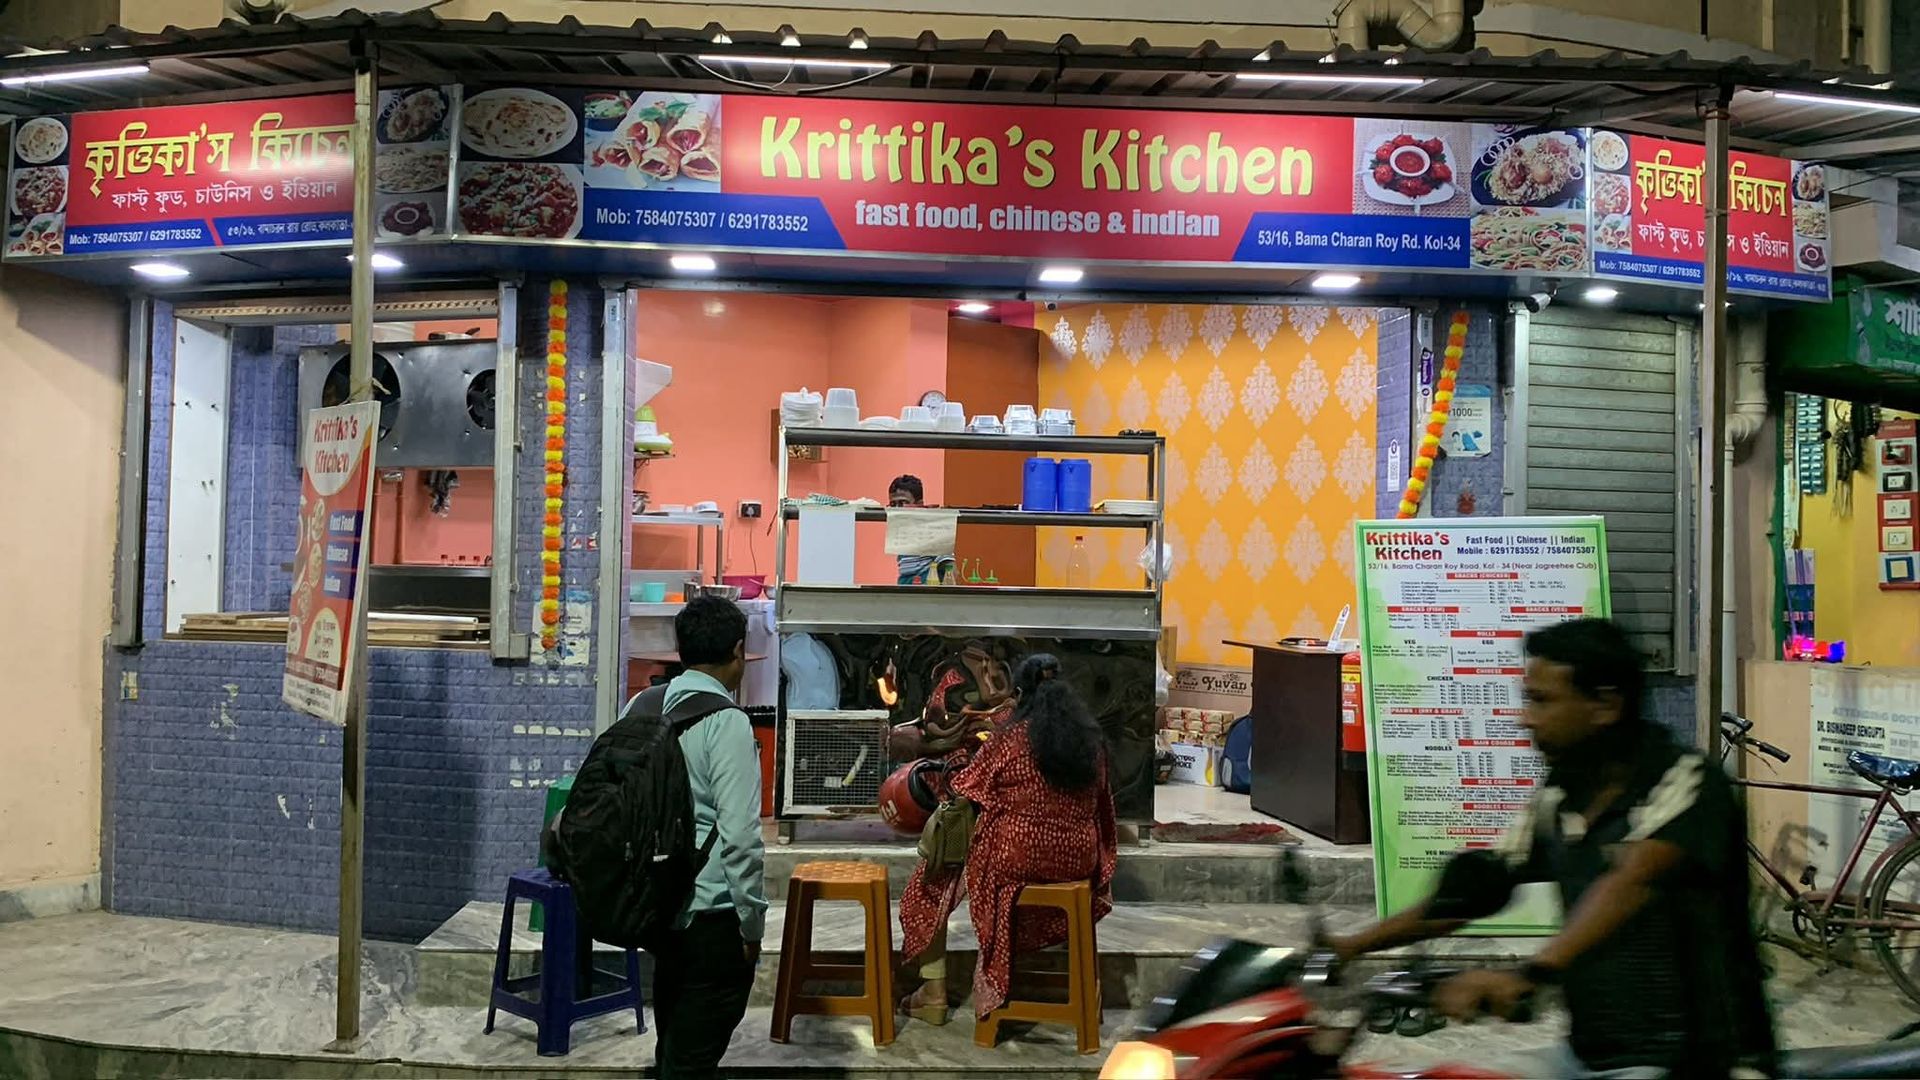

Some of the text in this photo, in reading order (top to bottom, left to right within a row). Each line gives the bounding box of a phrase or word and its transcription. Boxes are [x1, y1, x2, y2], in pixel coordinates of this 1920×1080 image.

[760, 116, 1313, 196] Krittika's Kitchen
[1635, 149, 1787, 217] কৃত্তিকা' কিচেন
[154, 190, 188, 214] ফুড,
[259, 185, 274, 201] ও
[596, 207, 809, 232] Mob: 7584075307 / 6291783552
[855, 200, 1220, 237] fast food, chinese & indian
[70, 233, 91, 245] Mob:
[93, 231, 143, 244] 7584075307
[150, 228, 202, 241] 6291783552
[1258, 230, 1461, 252] 53/16, Bama Charan Roy Rd. Kol-34
[1668, 226, 1693, 254] ফুড,
[1739, 235, 1750, 255] ও
[1600, 260, 1617, 270] Mob:
[314, 449, 350, 474] Kitchen
[1365, 531, 1450, 546] Krittika's
[1466, 535, 1483, 544] Fast
[1485, 535, 1503, 544] Food
[1516, 536, 1548, 545] Chinese
[1561, 535, 1586, 544] Indian
[1375, 546, 1443, 560] Kitchen
[1457, 547, 1484, 555] Mobile
[1490, 546, 1540, 555] 6291783552
[1546, 546, 1596, 555] 7584075307
[1392, 562, 1414, 570] Bama
[1415, 562, 1443, 570] Charan
[1444, 562, 1458, 571] Roy
[1483, 562, 1495, 570] Kol
[1512, 562, 1533, 570] (Near
[1576, 562, 1597, 570] Club)
[1201, 676, 1248, 691] Yuvan
[1173, 754, 1196, 763] OCTORS
[1175, 761, 1192, 769] HOICE
